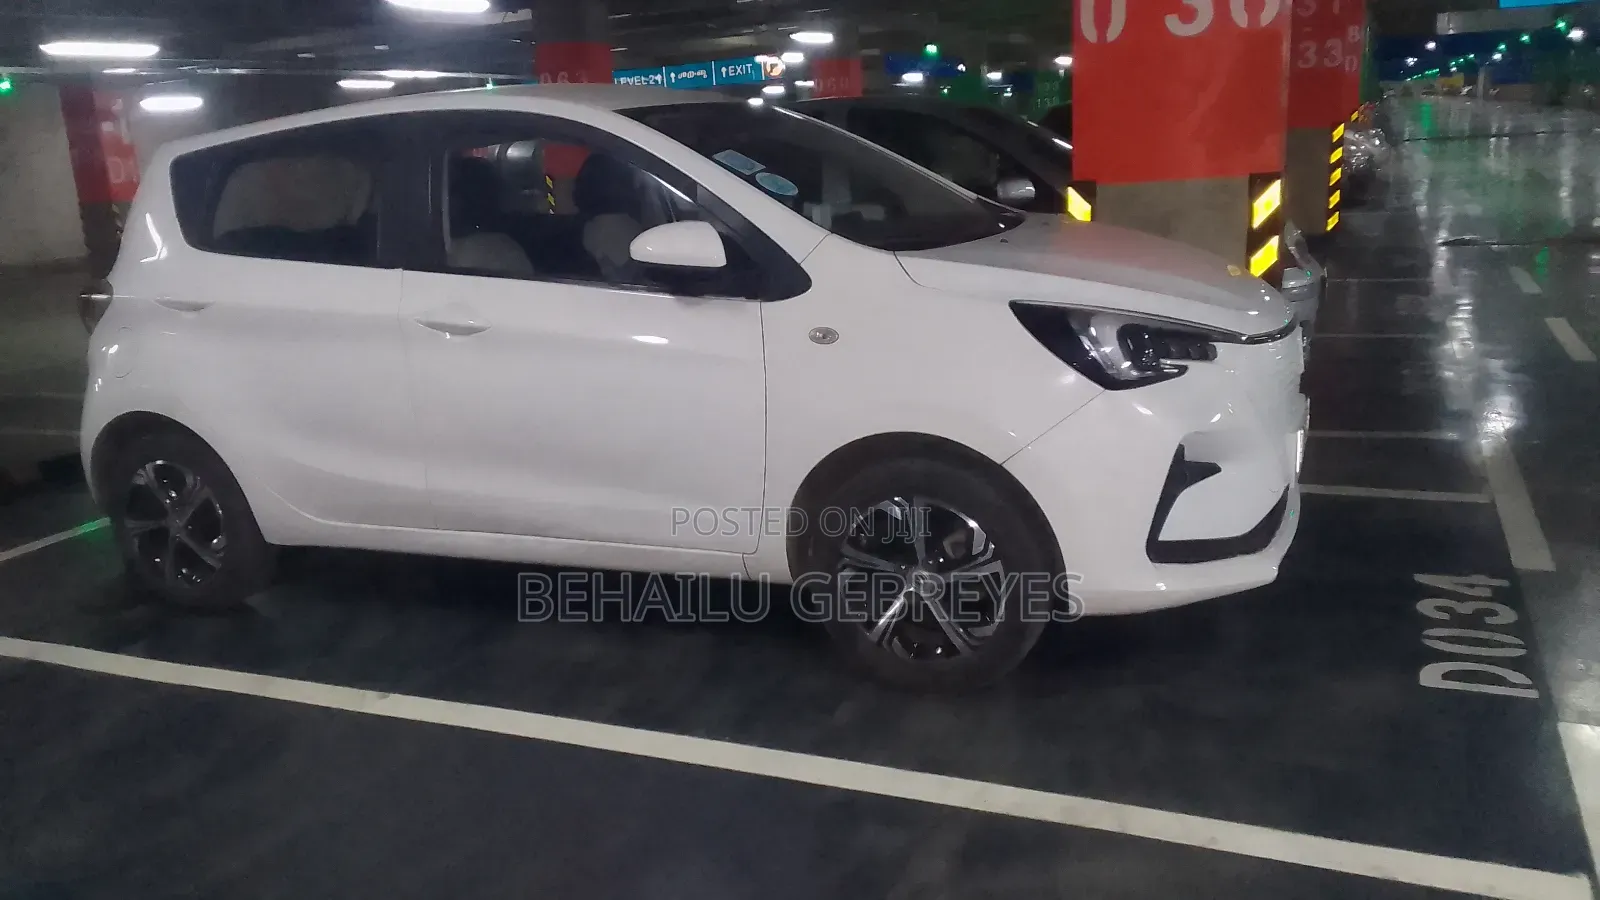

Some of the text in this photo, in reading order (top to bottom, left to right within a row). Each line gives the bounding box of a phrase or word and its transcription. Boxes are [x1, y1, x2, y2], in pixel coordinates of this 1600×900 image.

[1298, 38, 1343, 68] 33
[728, 63, 753, 77] EXIT
[1413, 573, 1540, 699] D034
